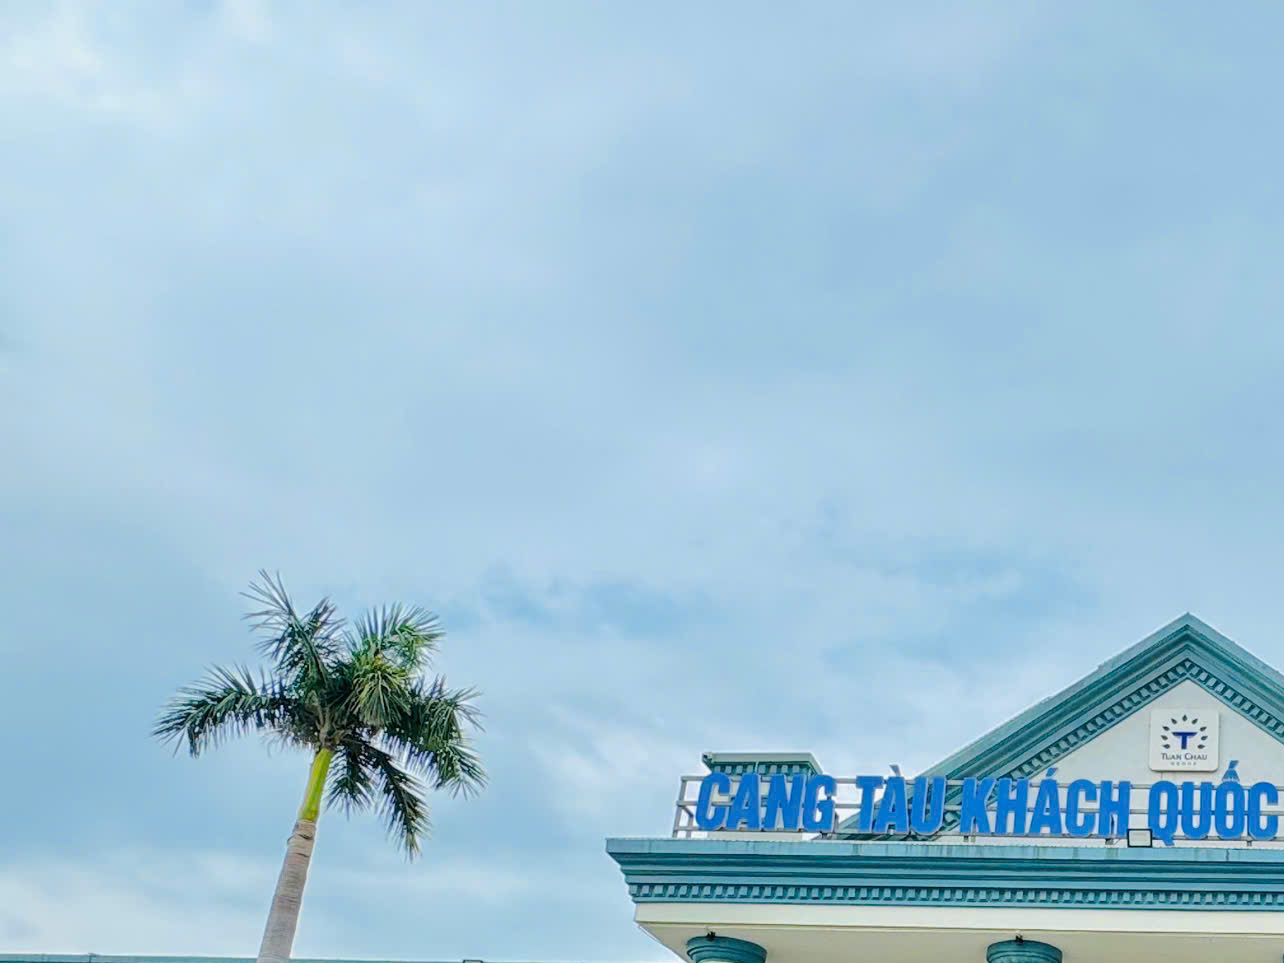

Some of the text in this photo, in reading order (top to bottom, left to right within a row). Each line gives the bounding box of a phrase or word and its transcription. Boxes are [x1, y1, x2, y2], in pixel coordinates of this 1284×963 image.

[856, 764, 945, 836] TÀU
[960, 767, 1130, 838] KHÁCH
[1148, 760, 1279, 845] QUỐC
